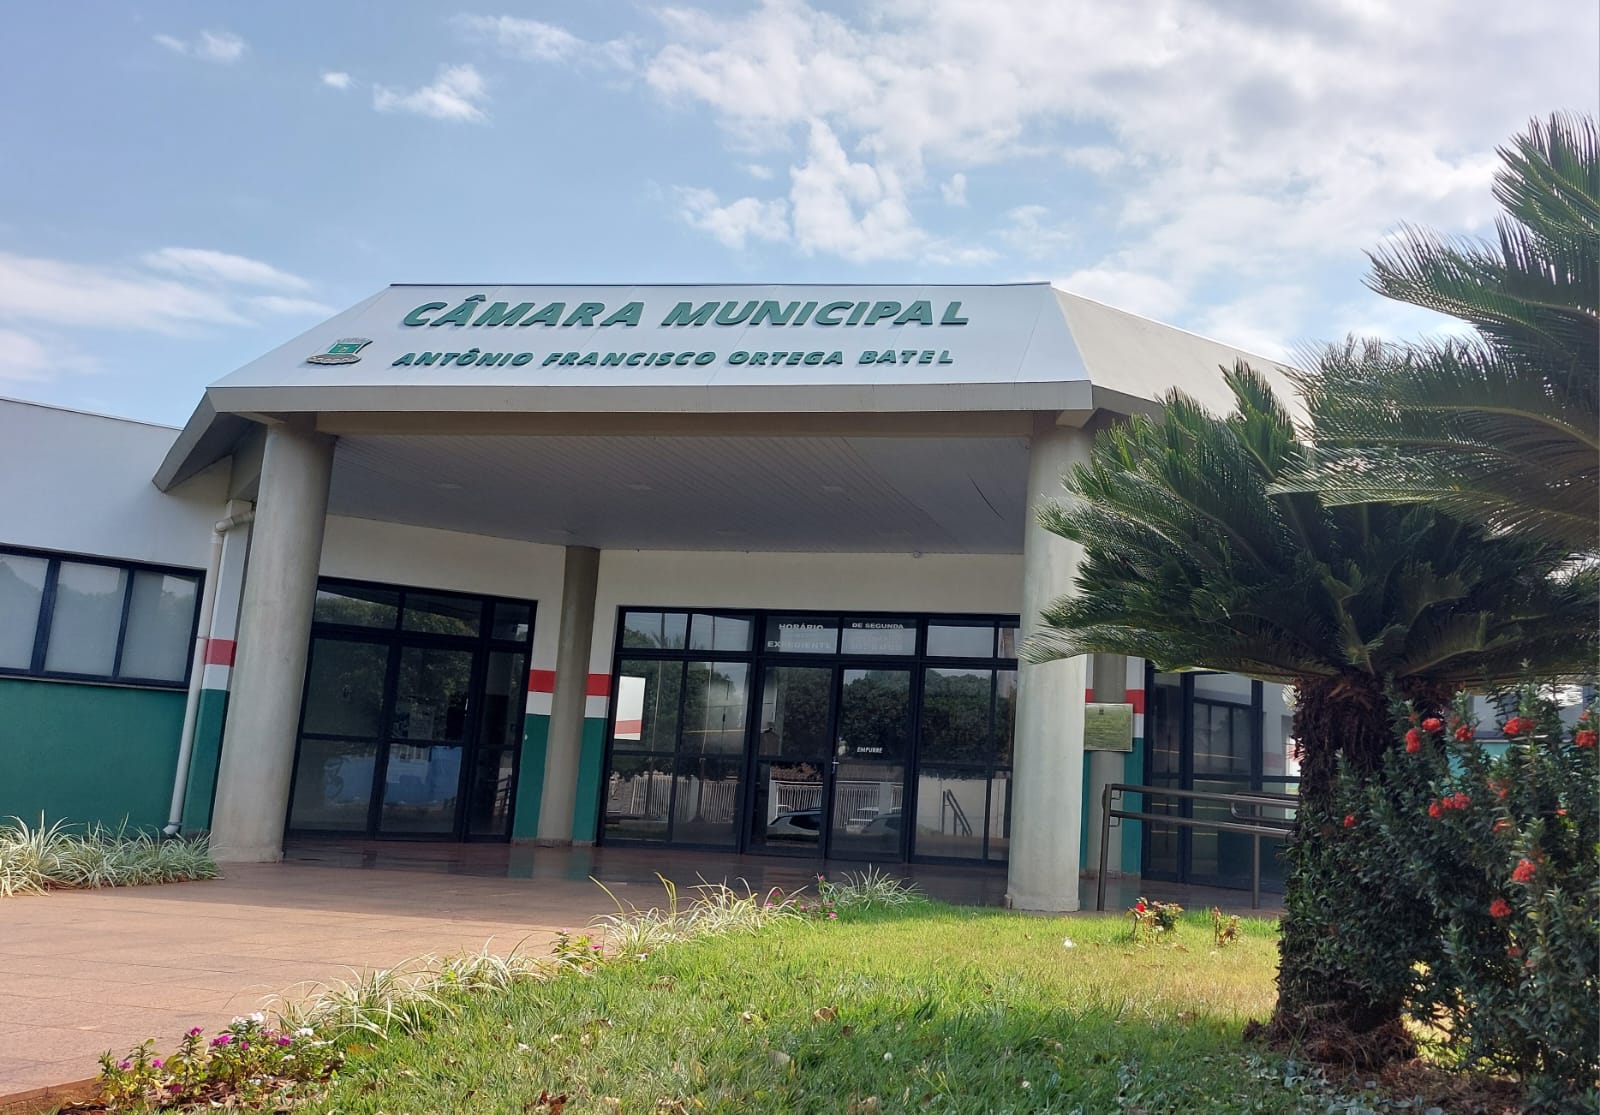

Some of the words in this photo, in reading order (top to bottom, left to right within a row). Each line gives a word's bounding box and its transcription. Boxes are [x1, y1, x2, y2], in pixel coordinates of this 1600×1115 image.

[403, 294, 645, 326] CÂMARA
[660, 300, 969, 326] MUNICIPAL
[391, 348, 534, 367] ANTÔNIO
[542, 351, 717, 367] FRANCISCO
[728, 351, 844, 366] ORTEGA
[858, 350, 954, 365] BATEL
[778, 622, 825, 631] HORÁRIO
